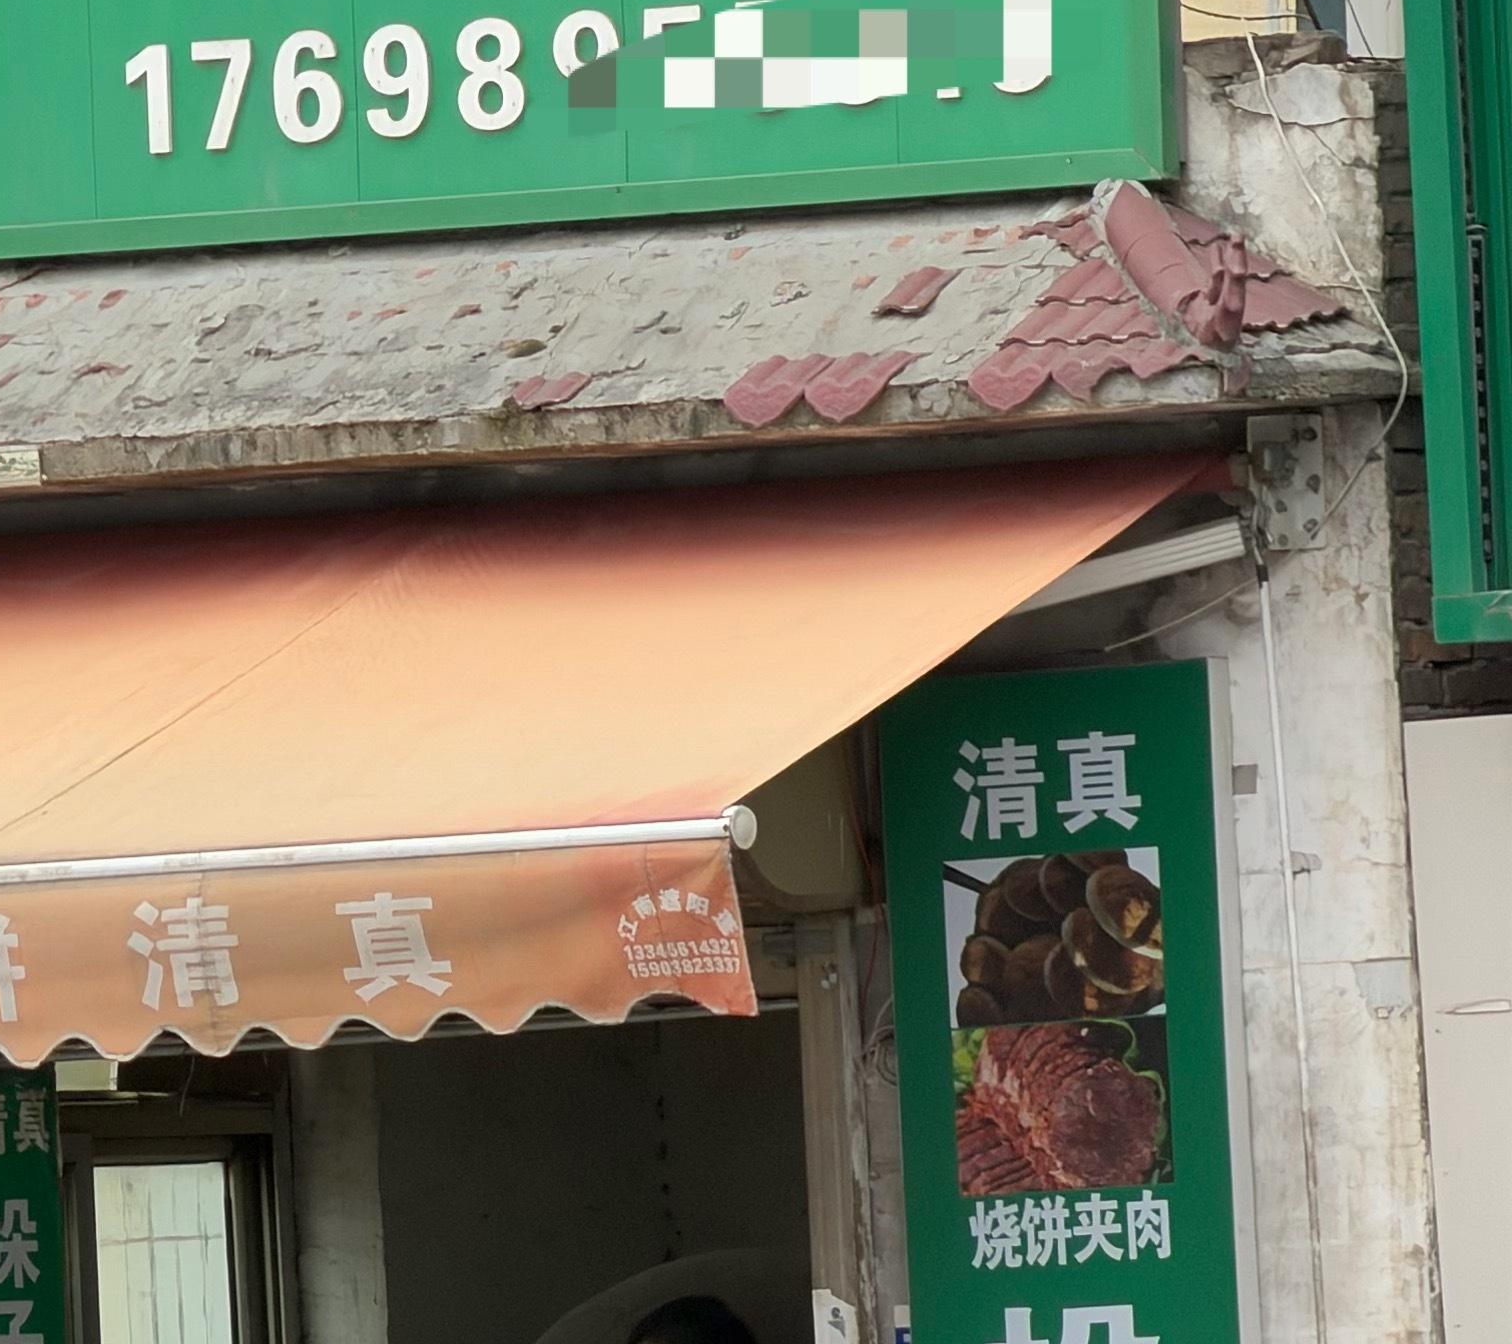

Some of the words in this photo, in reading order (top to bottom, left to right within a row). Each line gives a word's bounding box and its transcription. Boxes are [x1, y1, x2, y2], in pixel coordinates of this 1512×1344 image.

[952, 730, 1143, 841] 清真
[969, 1190, 1172, 1270] 烧饼夹肉
